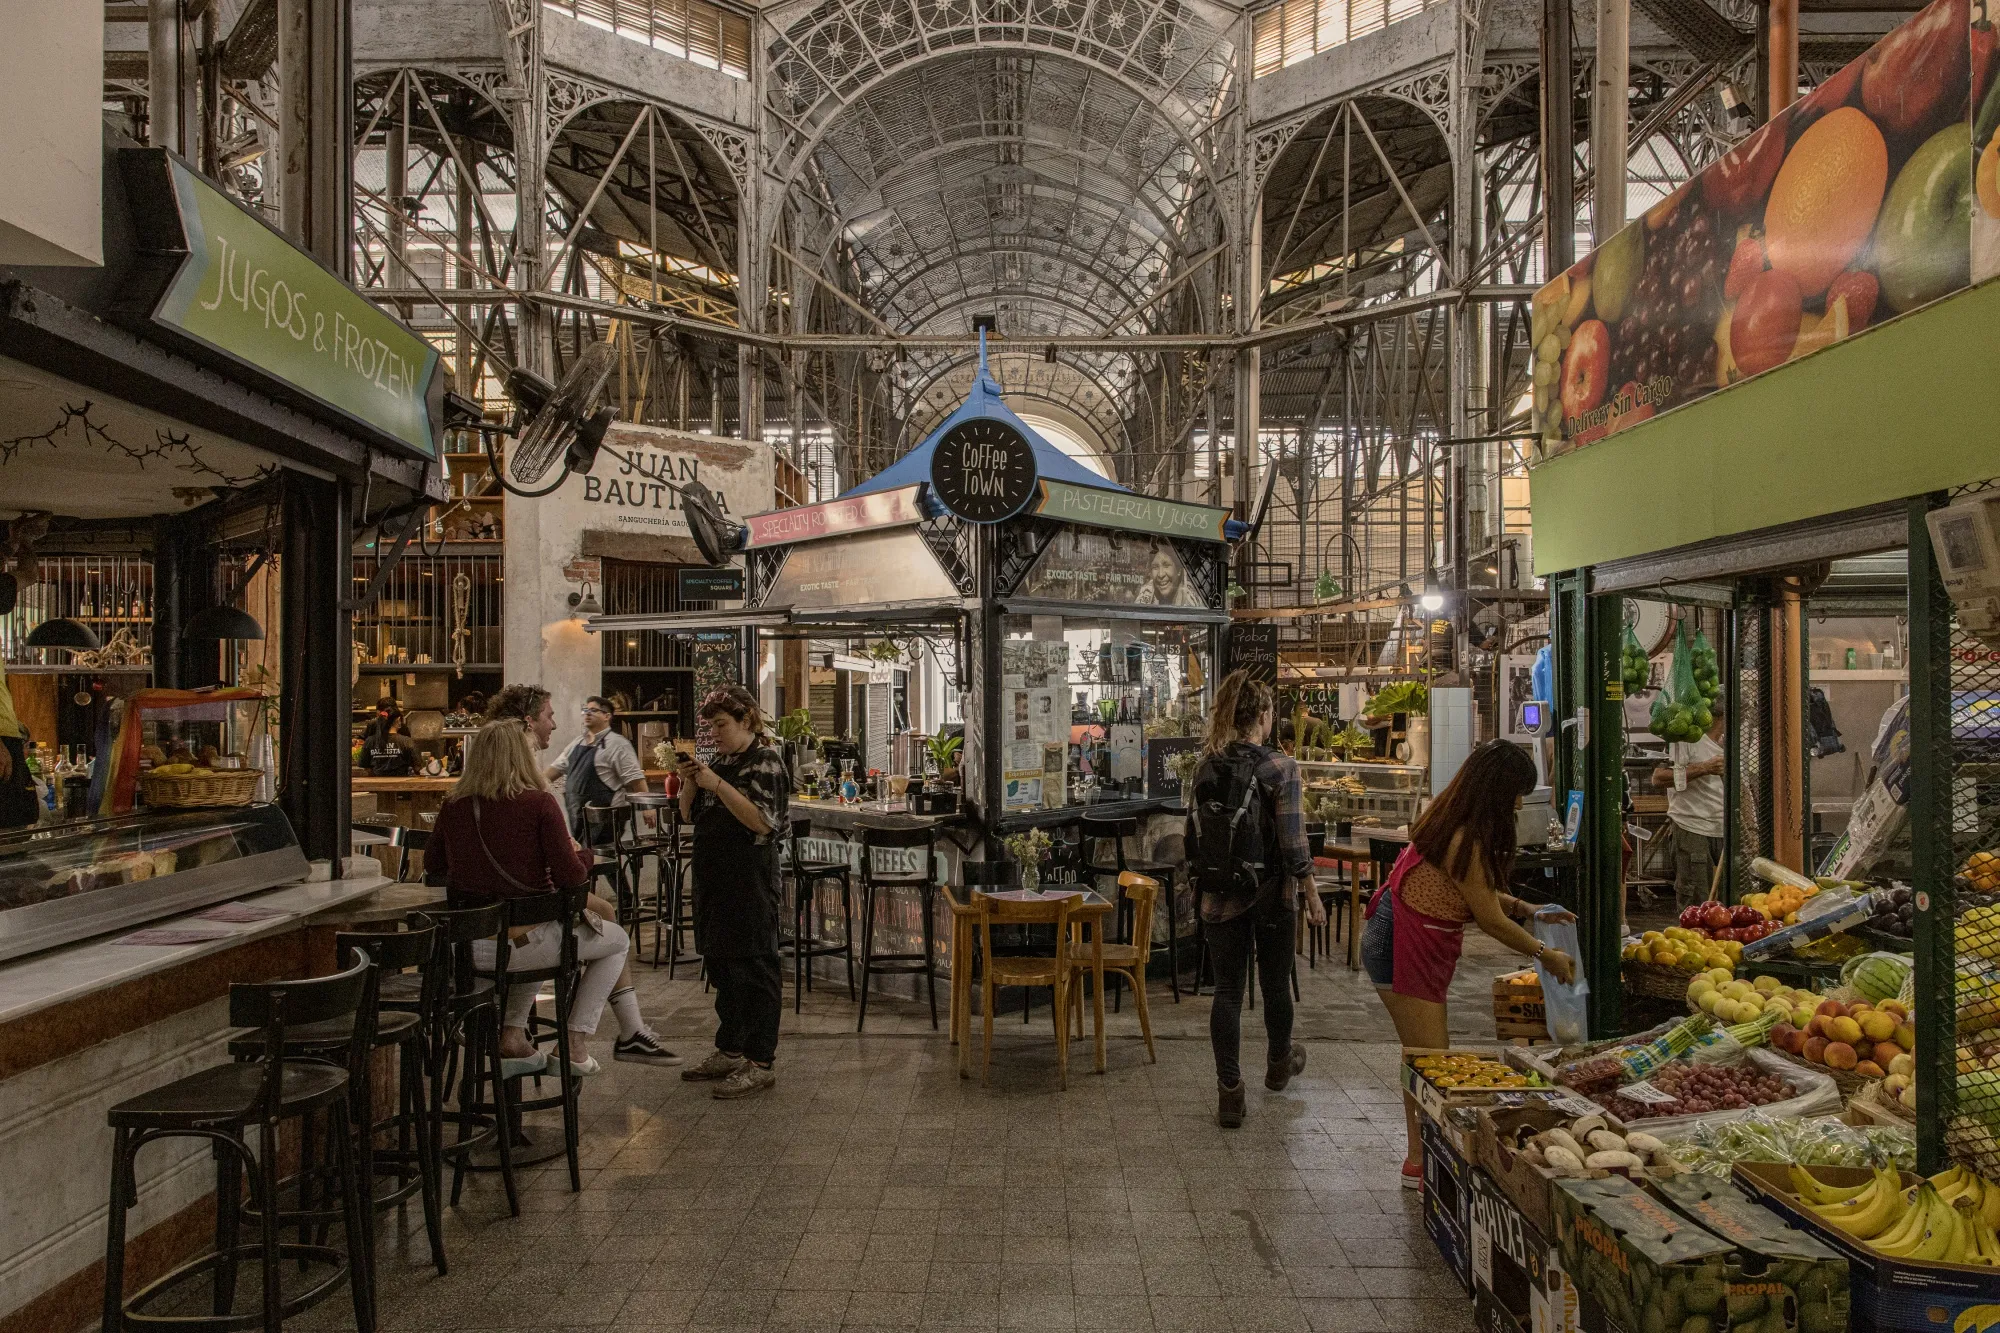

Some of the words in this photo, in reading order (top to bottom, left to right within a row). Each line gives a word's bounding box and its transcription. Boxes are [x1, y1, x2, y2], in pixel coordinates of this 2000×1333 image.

[201, 235, 307, 341] JUGOS
[313, 311, 328, 352] &
[334, 311, 414, 401] FROZEN
[1568, 402, 1610, 439] Delivery
[1613, 393, 1631, 418] Sin
[1635, 375, 1671, 408] Cargo
[619, 451, 699, 482] JUAN
[584, 475, 731, 515] BAUTIA
[618, 515, 670, 526] SANGUCHERÍA
[1063, 489, 1151, 521] PASTELERIA
[1164, 508, 1209, 530] JUGOS
[763, 513, 810, 537] SPECIALTY
[800, 583, 820, 592] EXOTIC
[821, 581, 839, 590] TASTE
[1046, 569, 1073, 580] EXOTIC
[1074, 571, 1097, 582] TASTE
[1232, 627, 1270, 643] Probá
[1230, 646, 1276, 663] Nuestras
[1574, 1212, 1631, 1277] PROPAL
[1725, 1282, 1784, 1296] PROPAL
